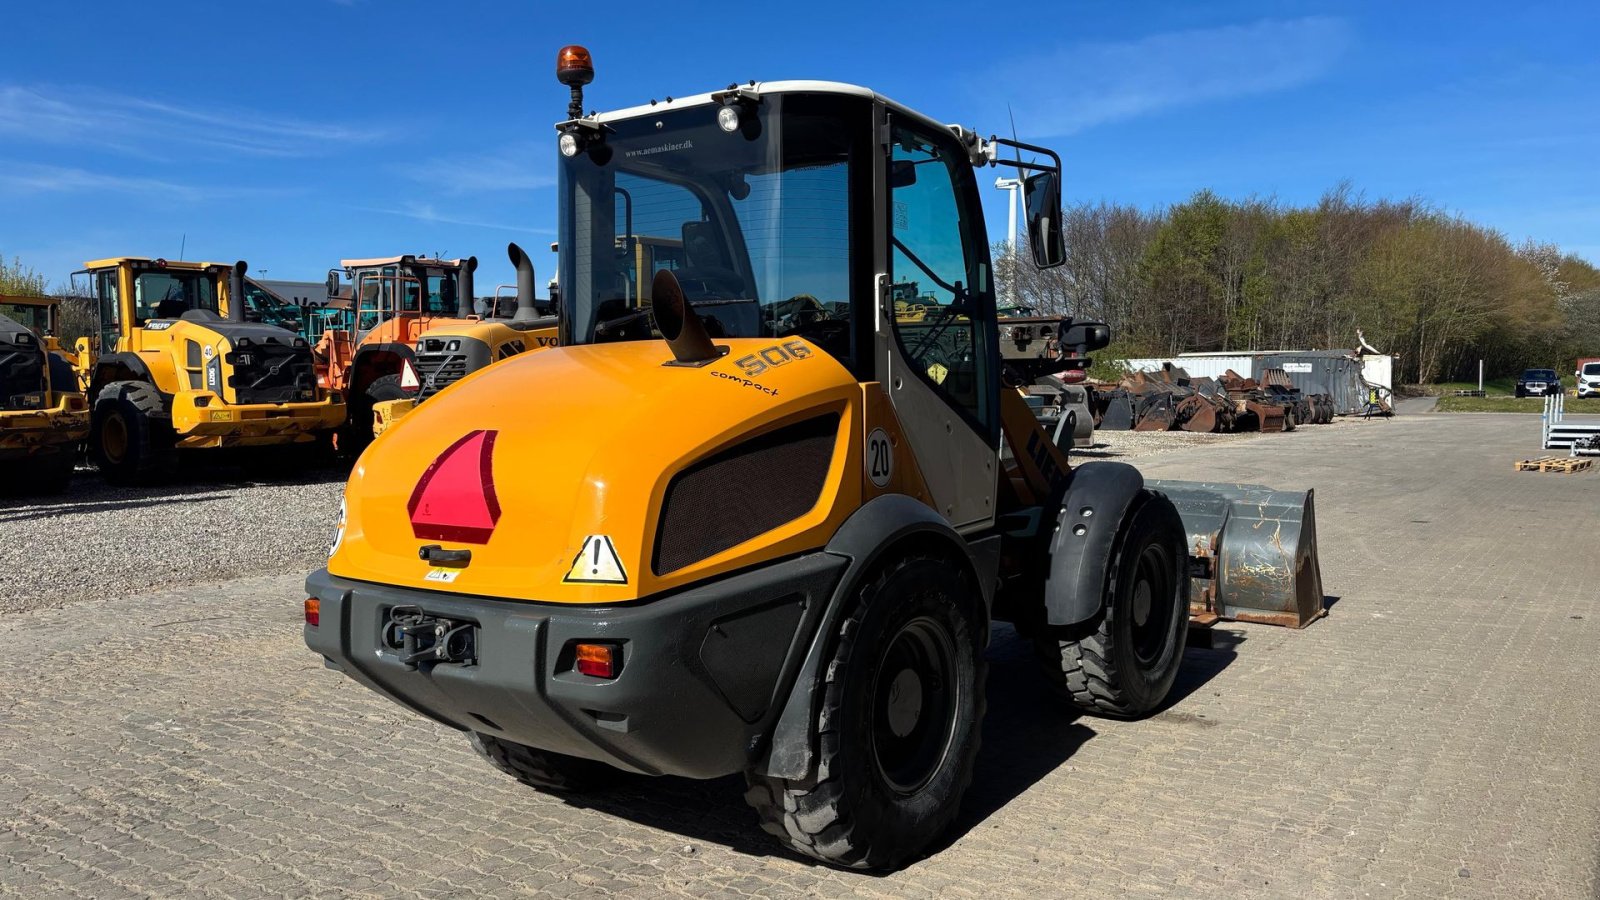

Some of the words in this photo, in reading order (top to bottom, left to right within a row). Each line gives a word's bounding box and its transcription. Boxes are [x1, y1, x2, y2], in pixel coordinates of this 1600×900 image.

[204, 347, 213, 357] 40
[734, 340, 814, 377] 506
[710, 371, 779, 397] compact
[870, 439, 889, 478] 20
